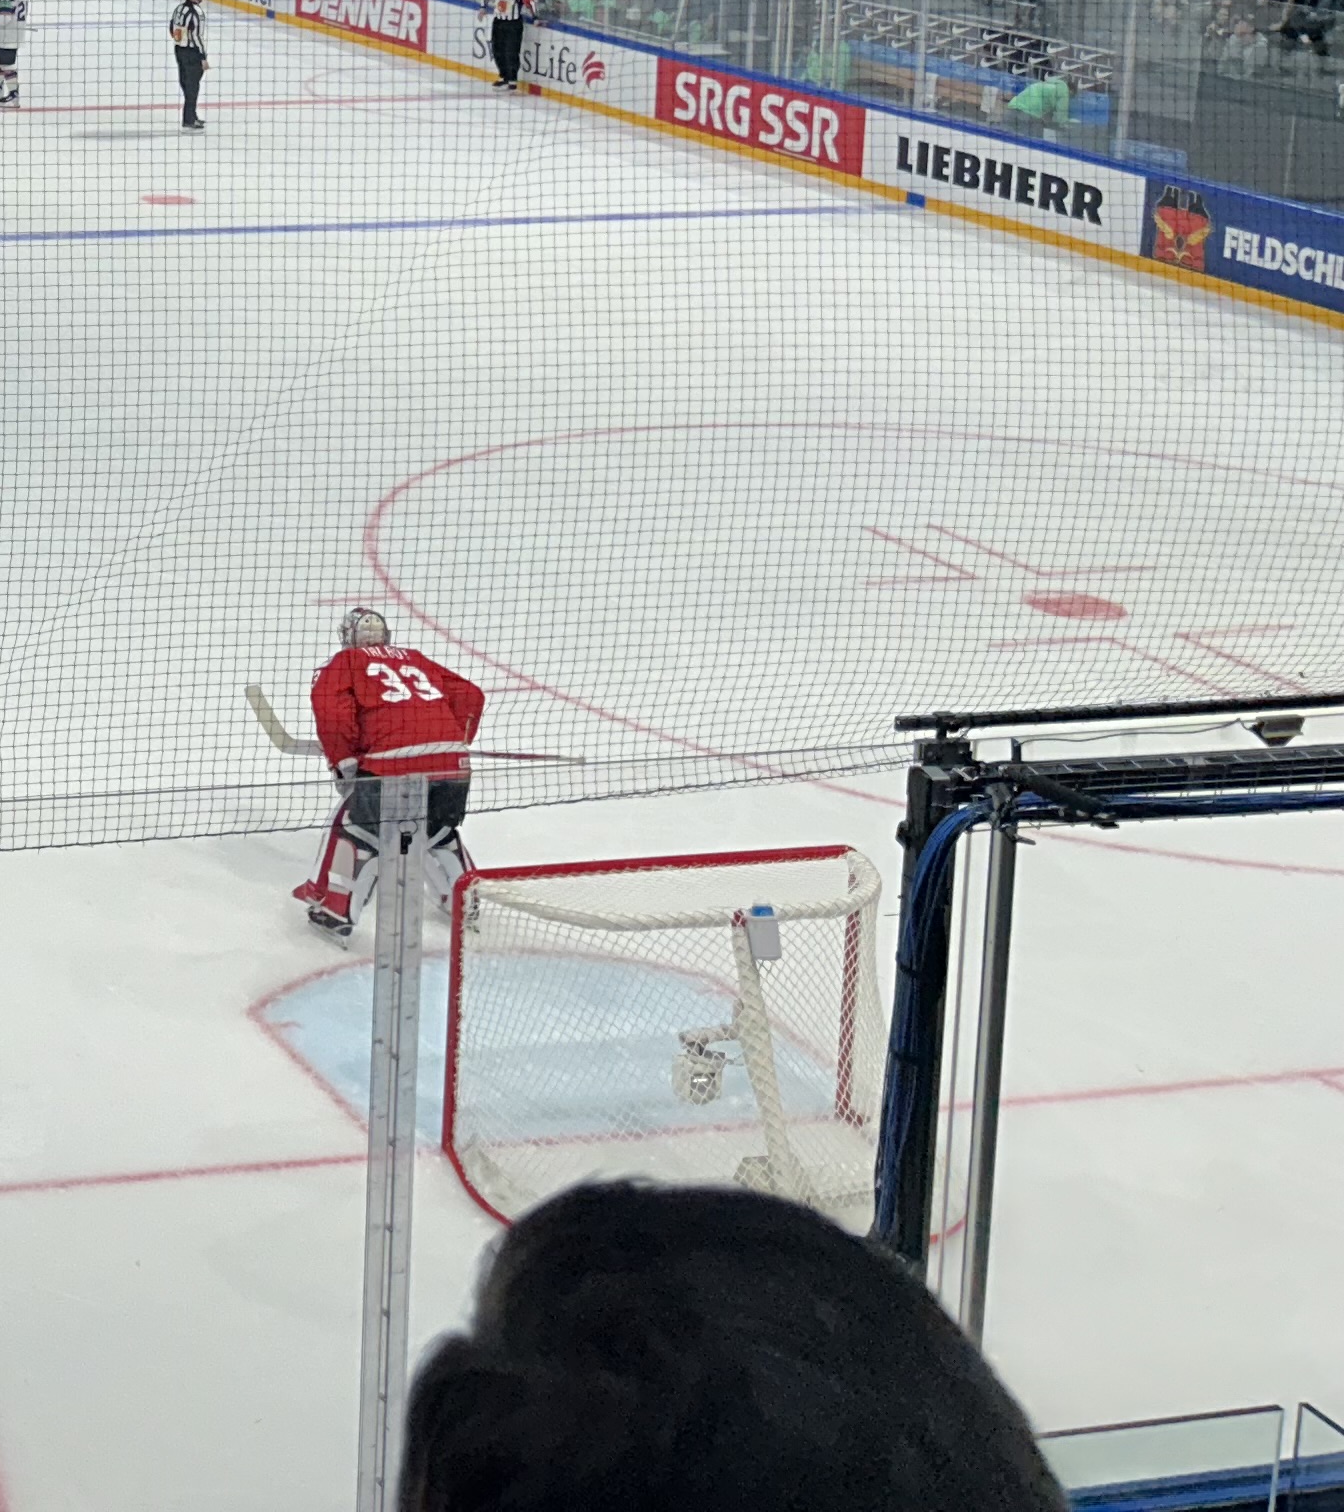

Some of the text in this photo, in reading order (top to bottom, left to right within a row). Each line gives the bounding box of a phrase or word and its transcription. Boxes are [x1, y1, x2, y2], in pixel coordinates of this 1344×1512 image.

[674, 70, 840, 164] SRG SSR
[896, 135, 1104, 226] LIEBHERR
[367, 662, 444, 703] 33
